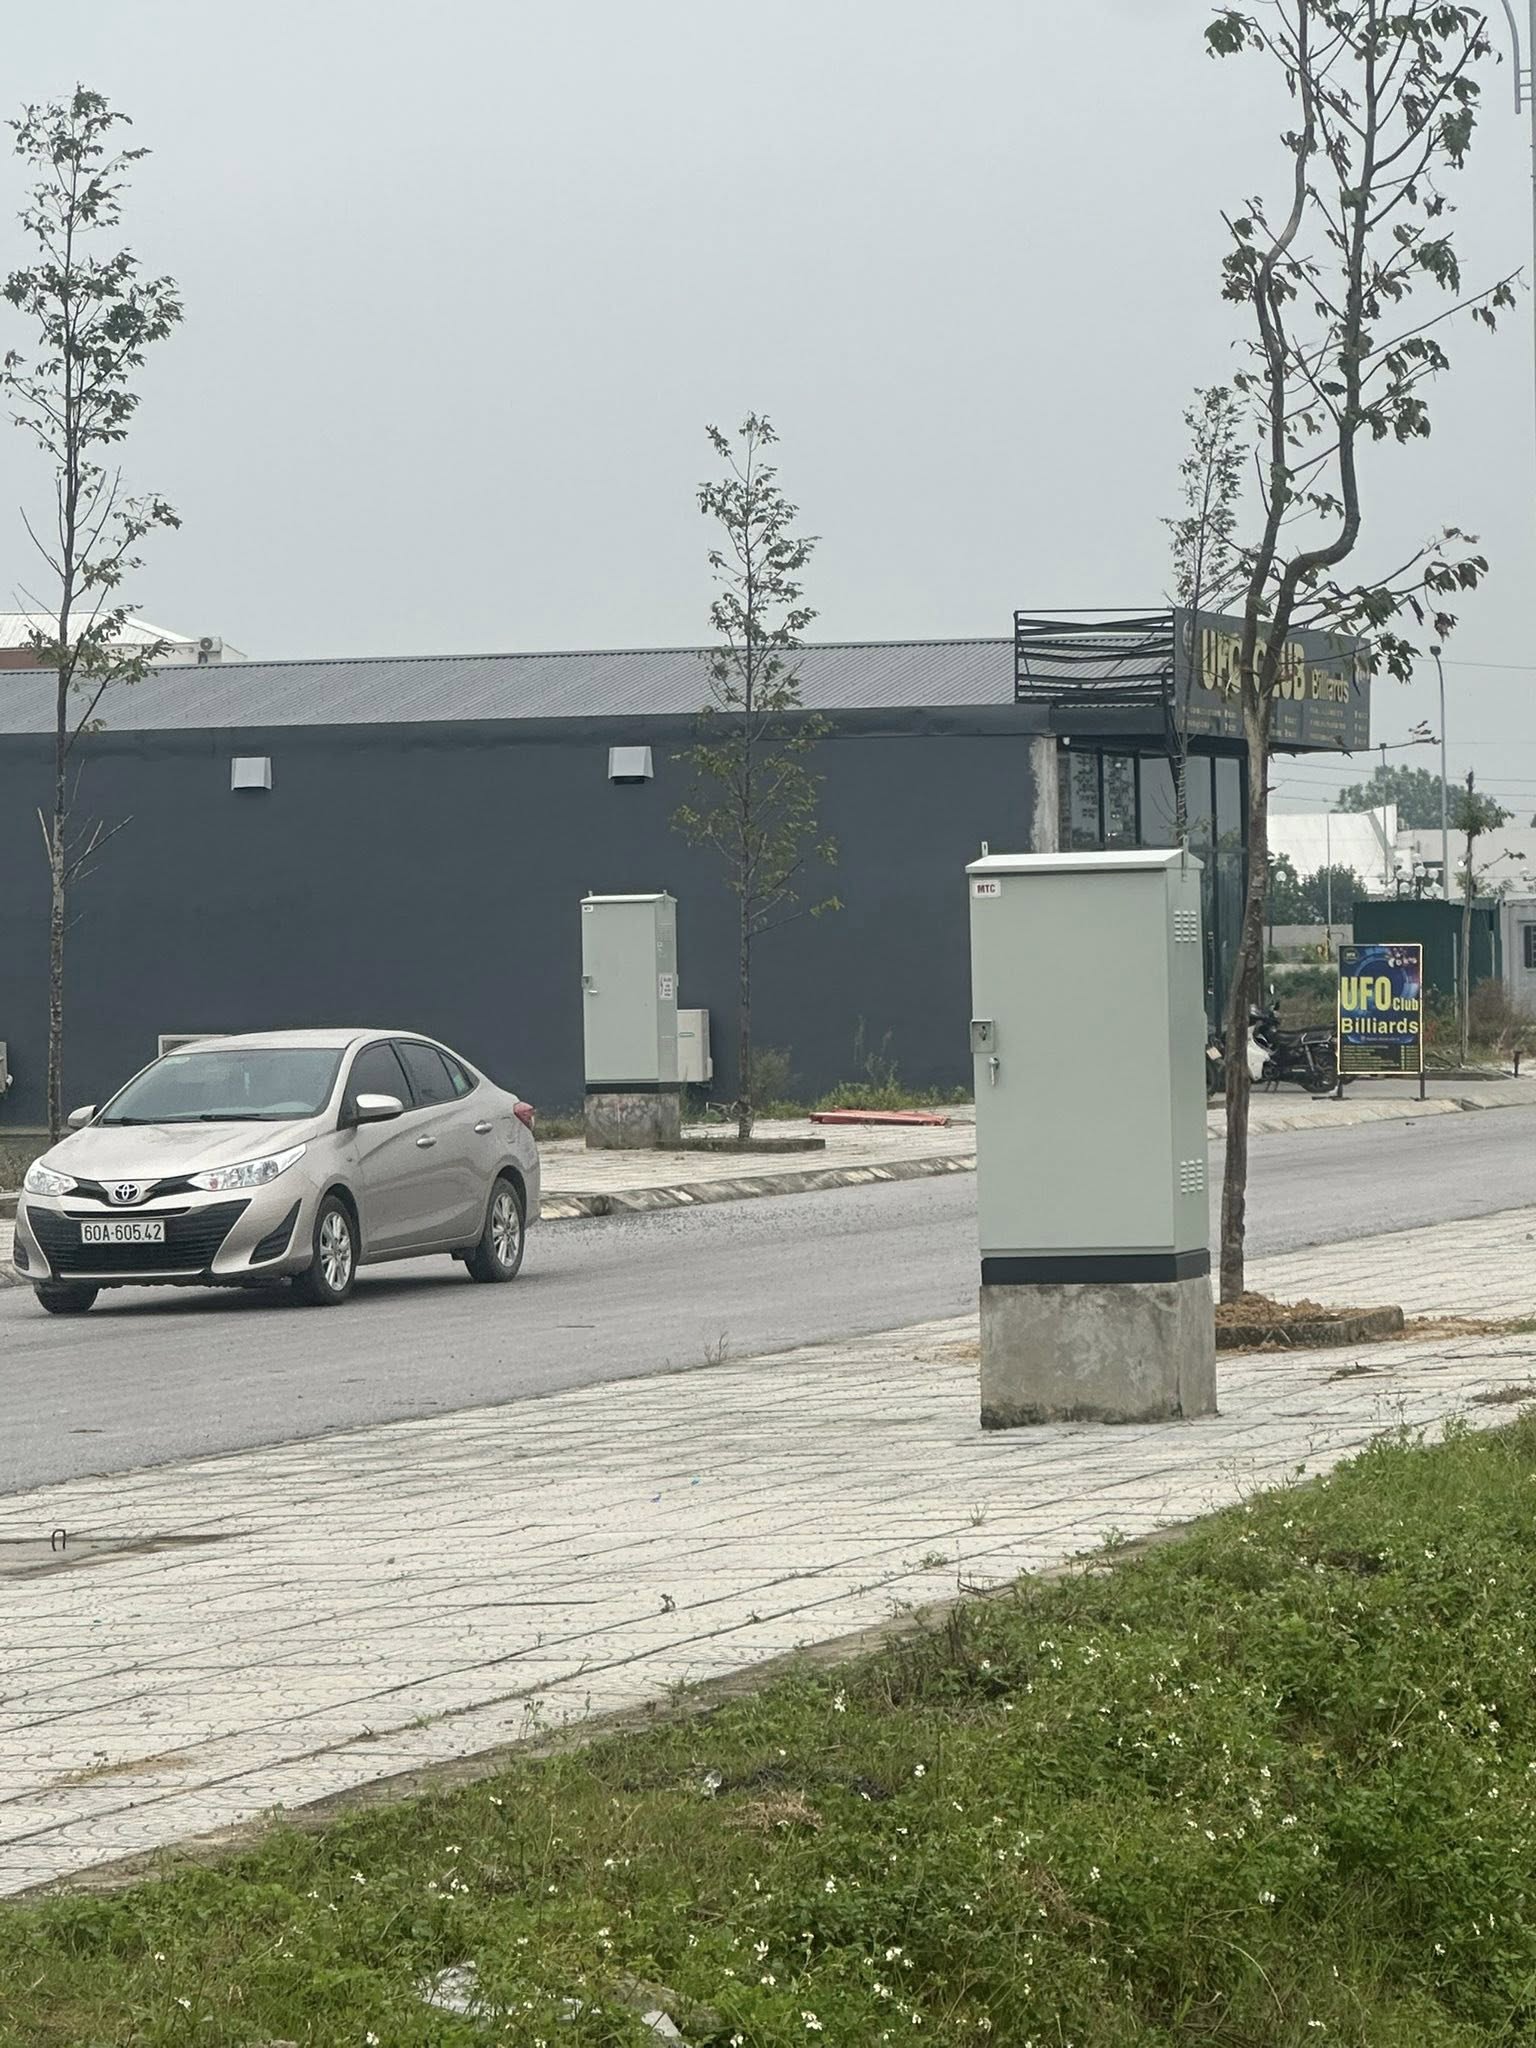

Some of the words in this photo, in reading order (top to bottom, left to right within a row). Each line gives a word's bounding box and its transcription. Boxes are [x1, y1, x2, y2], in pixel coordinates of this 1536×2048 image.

[1252, 639, 1305, 701] CUB
[1311, 668, 1350, 704] Billiards
[977, 884, 995, 894] MTC
[1341, 976, 1392, 1011] UFO
[1393, 997, 1419, 1011] Club
[1341, 1017, 1419, 1034] Billiards
[85, 1224, 162, 1241] 60A-605.42
